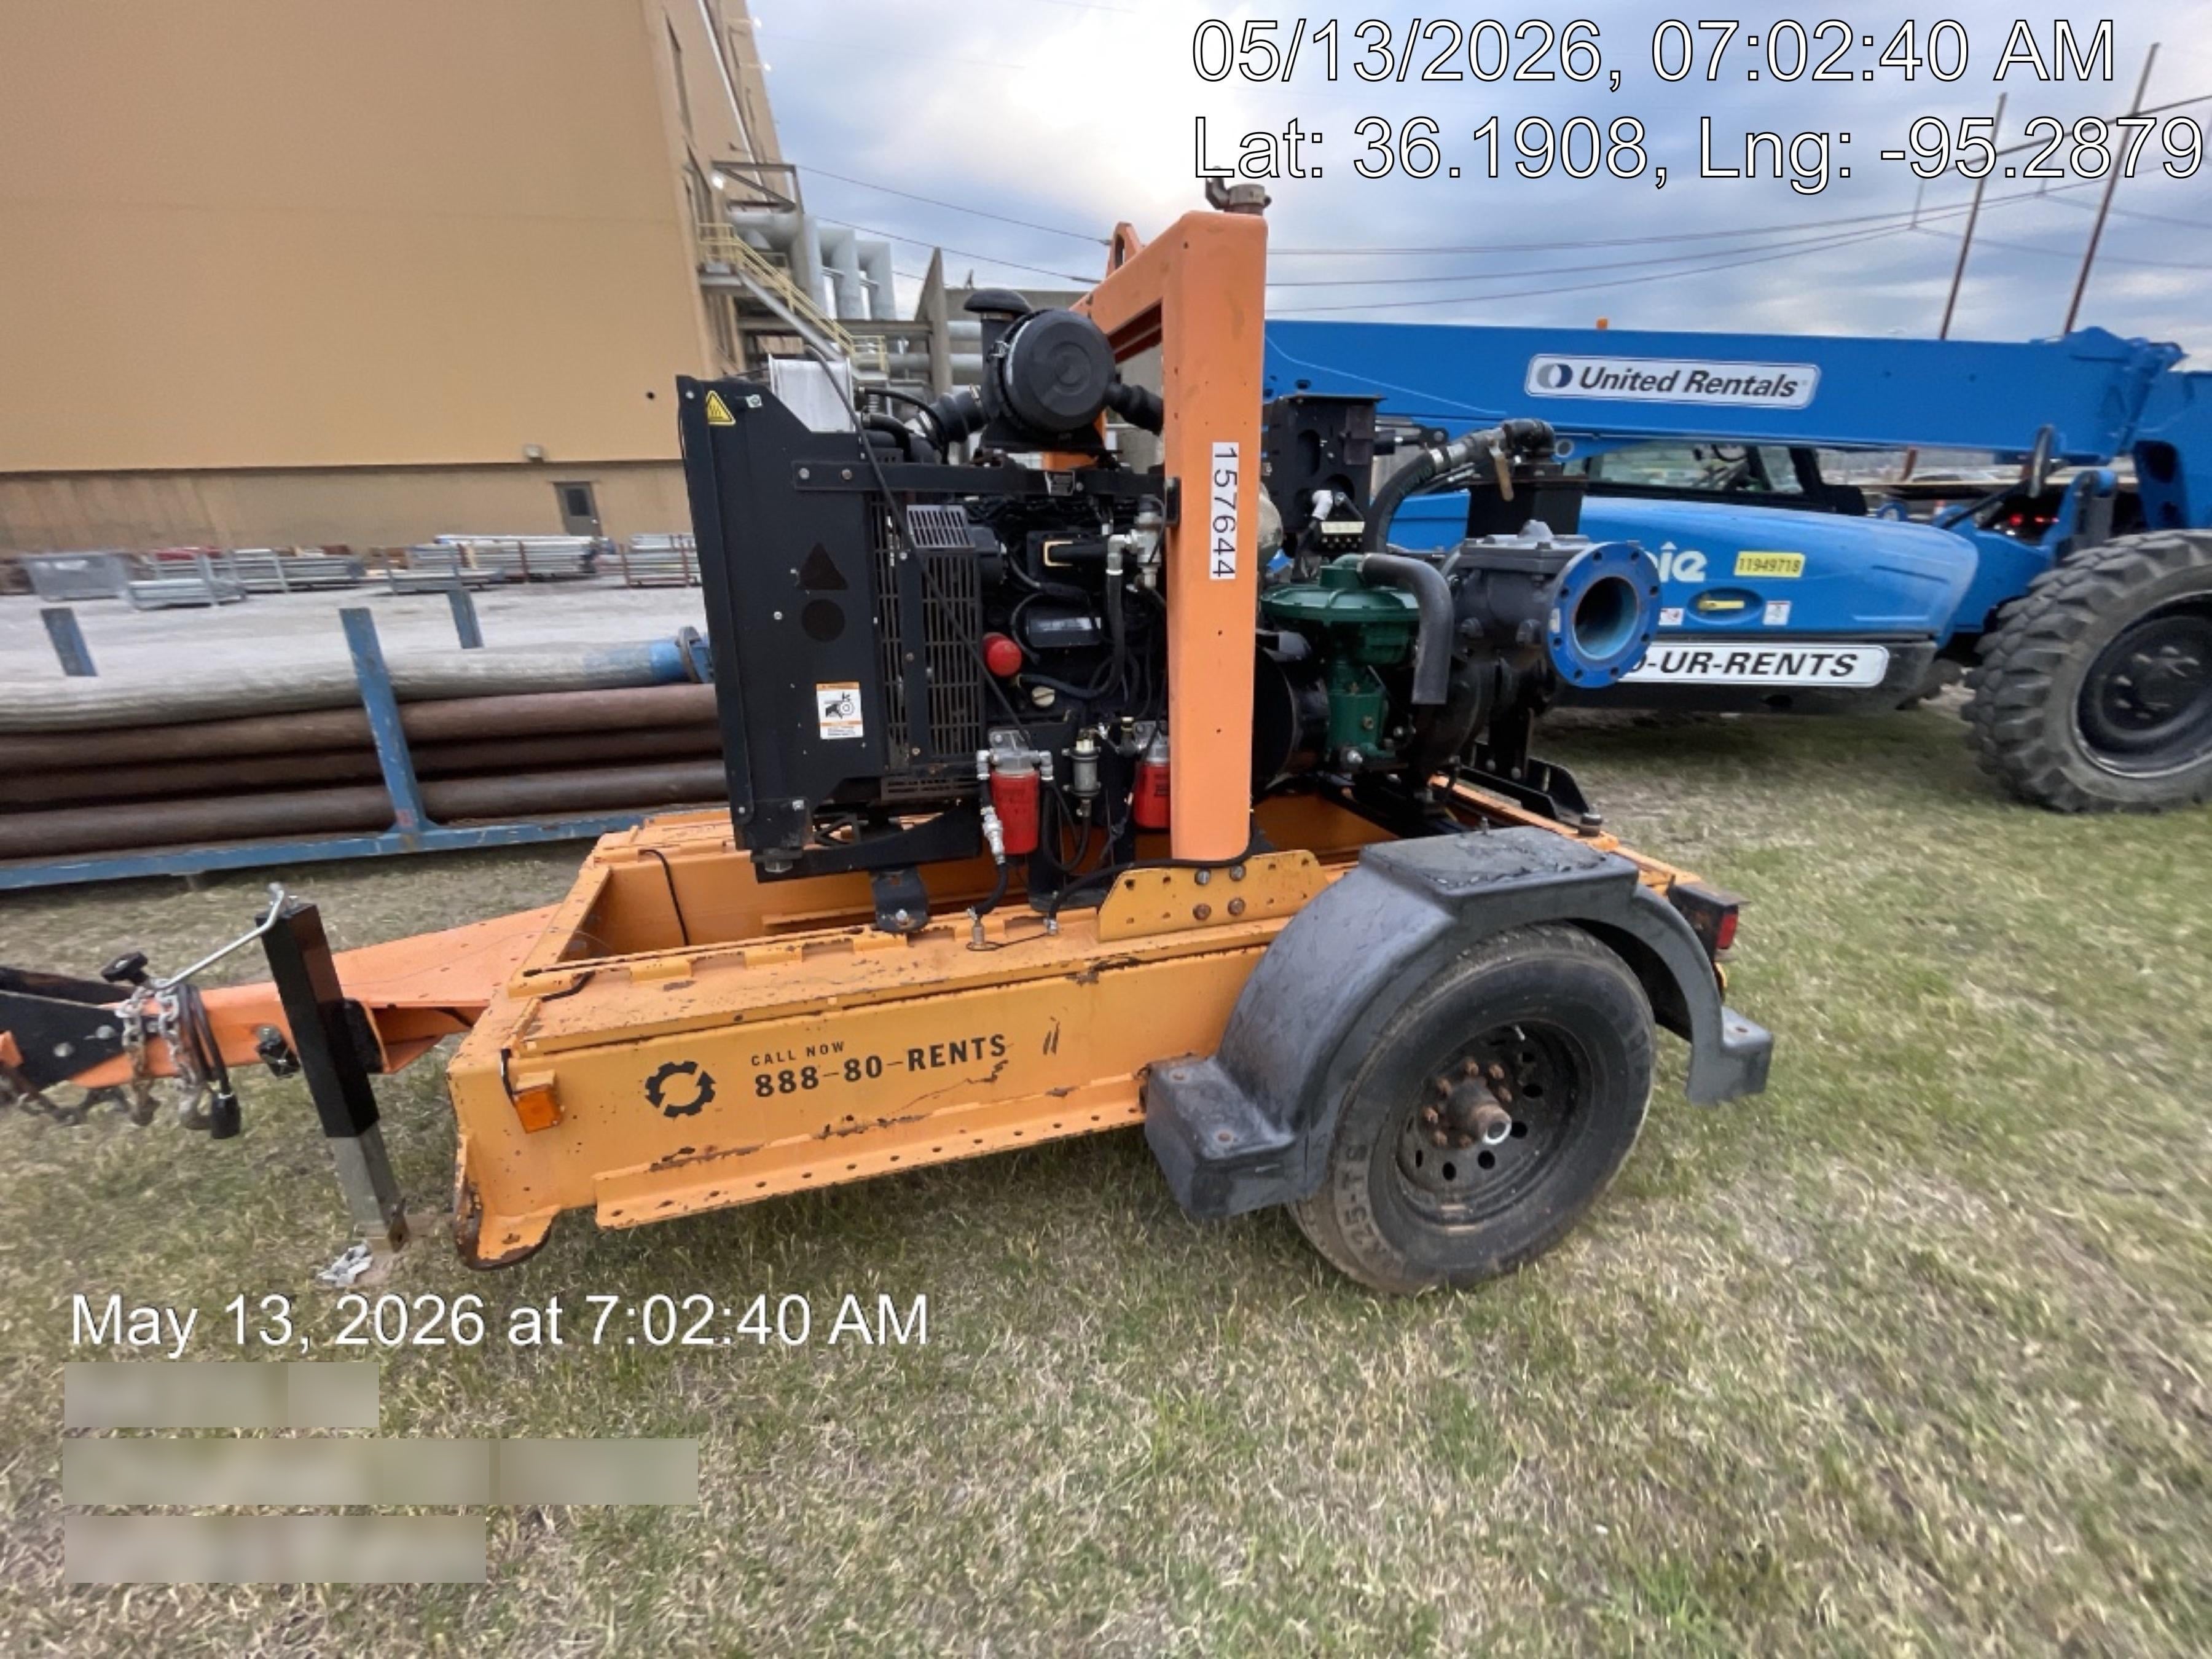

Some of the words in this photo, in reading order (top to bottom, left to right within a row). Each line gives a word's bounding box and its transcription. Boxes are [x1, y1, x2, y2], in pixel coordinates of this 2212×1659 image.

[1579, 366, 1680, 393] United
[1683, 369, 1798, 398] Rentals
[1212, 447, 1237, 578] 157644
[751, 1049, 796, 1066] CALL
[806, 1041, 845, 1057] NOW
[755, 1034, 1006, 1098] 888-80-RENTS
